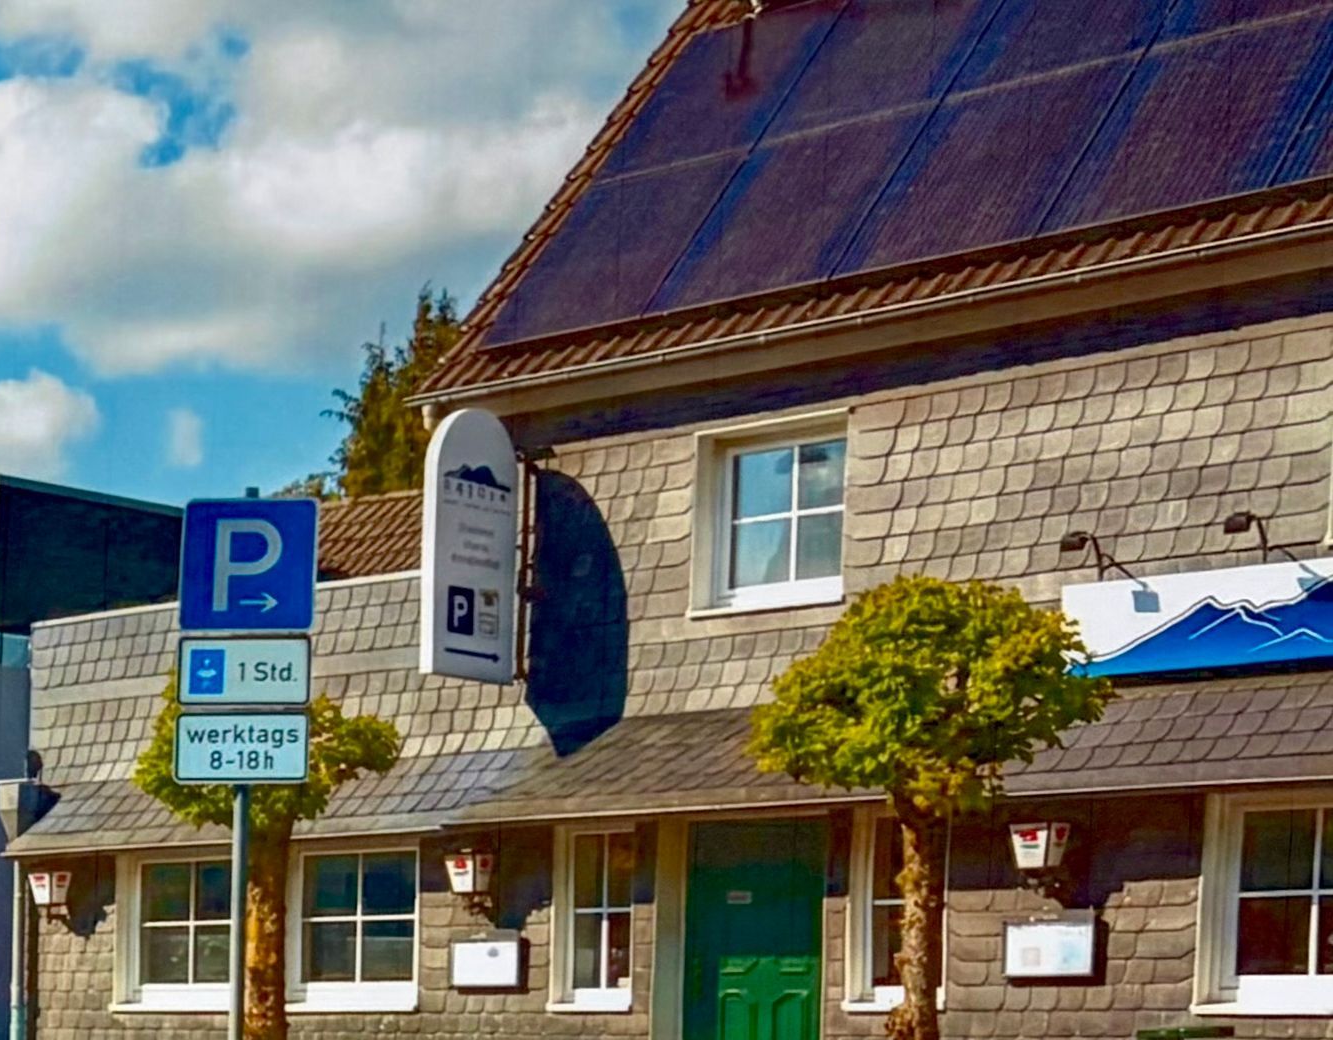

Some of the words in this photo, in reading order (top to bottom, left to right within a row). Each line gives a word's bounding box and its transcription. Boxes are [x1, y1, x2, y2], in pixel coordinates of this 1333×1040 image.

[212, 518, 283, 612] P
[453, 595, 469, 628] P
[237, 662, 245, 682] 1
[253, 661, 298, 683] Std.
[187, 725, 299, 748] werktags
